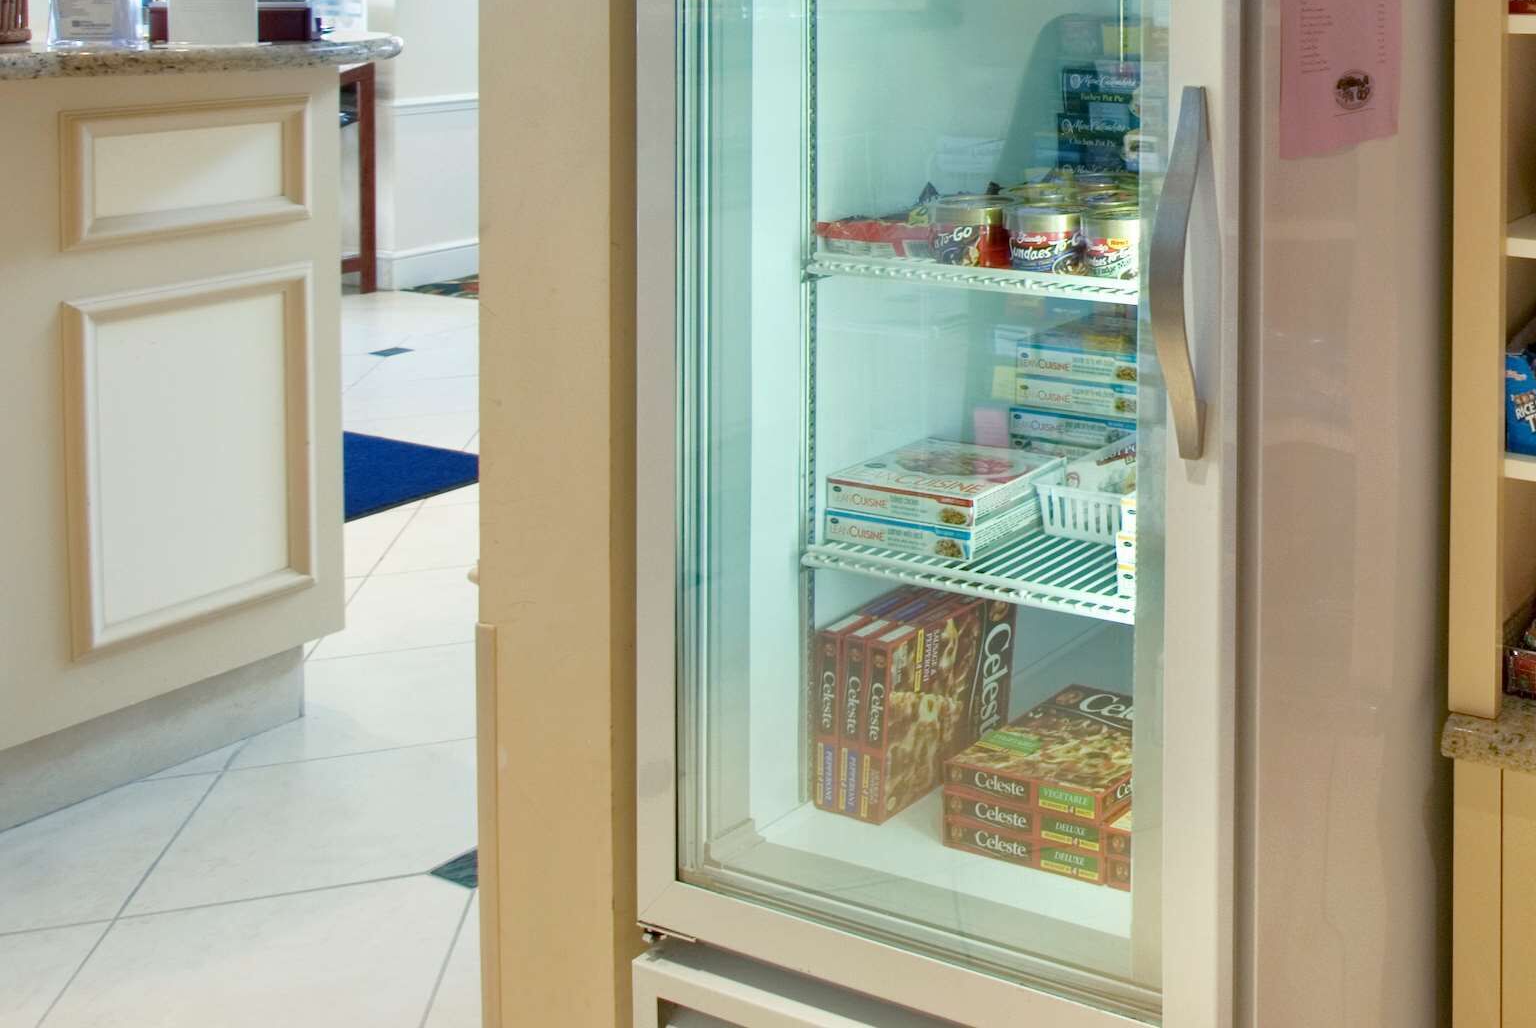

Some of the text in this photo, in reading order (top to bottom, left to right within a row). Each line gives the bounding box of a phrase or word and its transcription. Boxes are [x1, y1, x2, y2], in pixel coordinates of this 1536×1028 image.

[1008, 236, 1051, 261] Sundaes
[1037, 357, 1072, 373] CUISINE
[1037, 388, 1073, 405] CUISINE
[1515, 399, 1535, 421] RICE
[893, 470, 987, 495] CUISINE
[852, 493, 889, 510] CUISINE
[850, 524, 886, 542] CUISINE
[822, 670, 836, 729] Celeste
[846, 675, 862, 735] Celeste
[868, 682, 885, 742] Celeste
[974, 771, 1025, 797] Celeste
[1042, 787, 1090, 806] VEGETABLE
[974, 802, 1027, 829] Celeste
[1055, 821, 1087, 837] DELUXE
[974, 829, 1027, 856] Celeste
[1053, 850, 1086, 867] DELUXE
